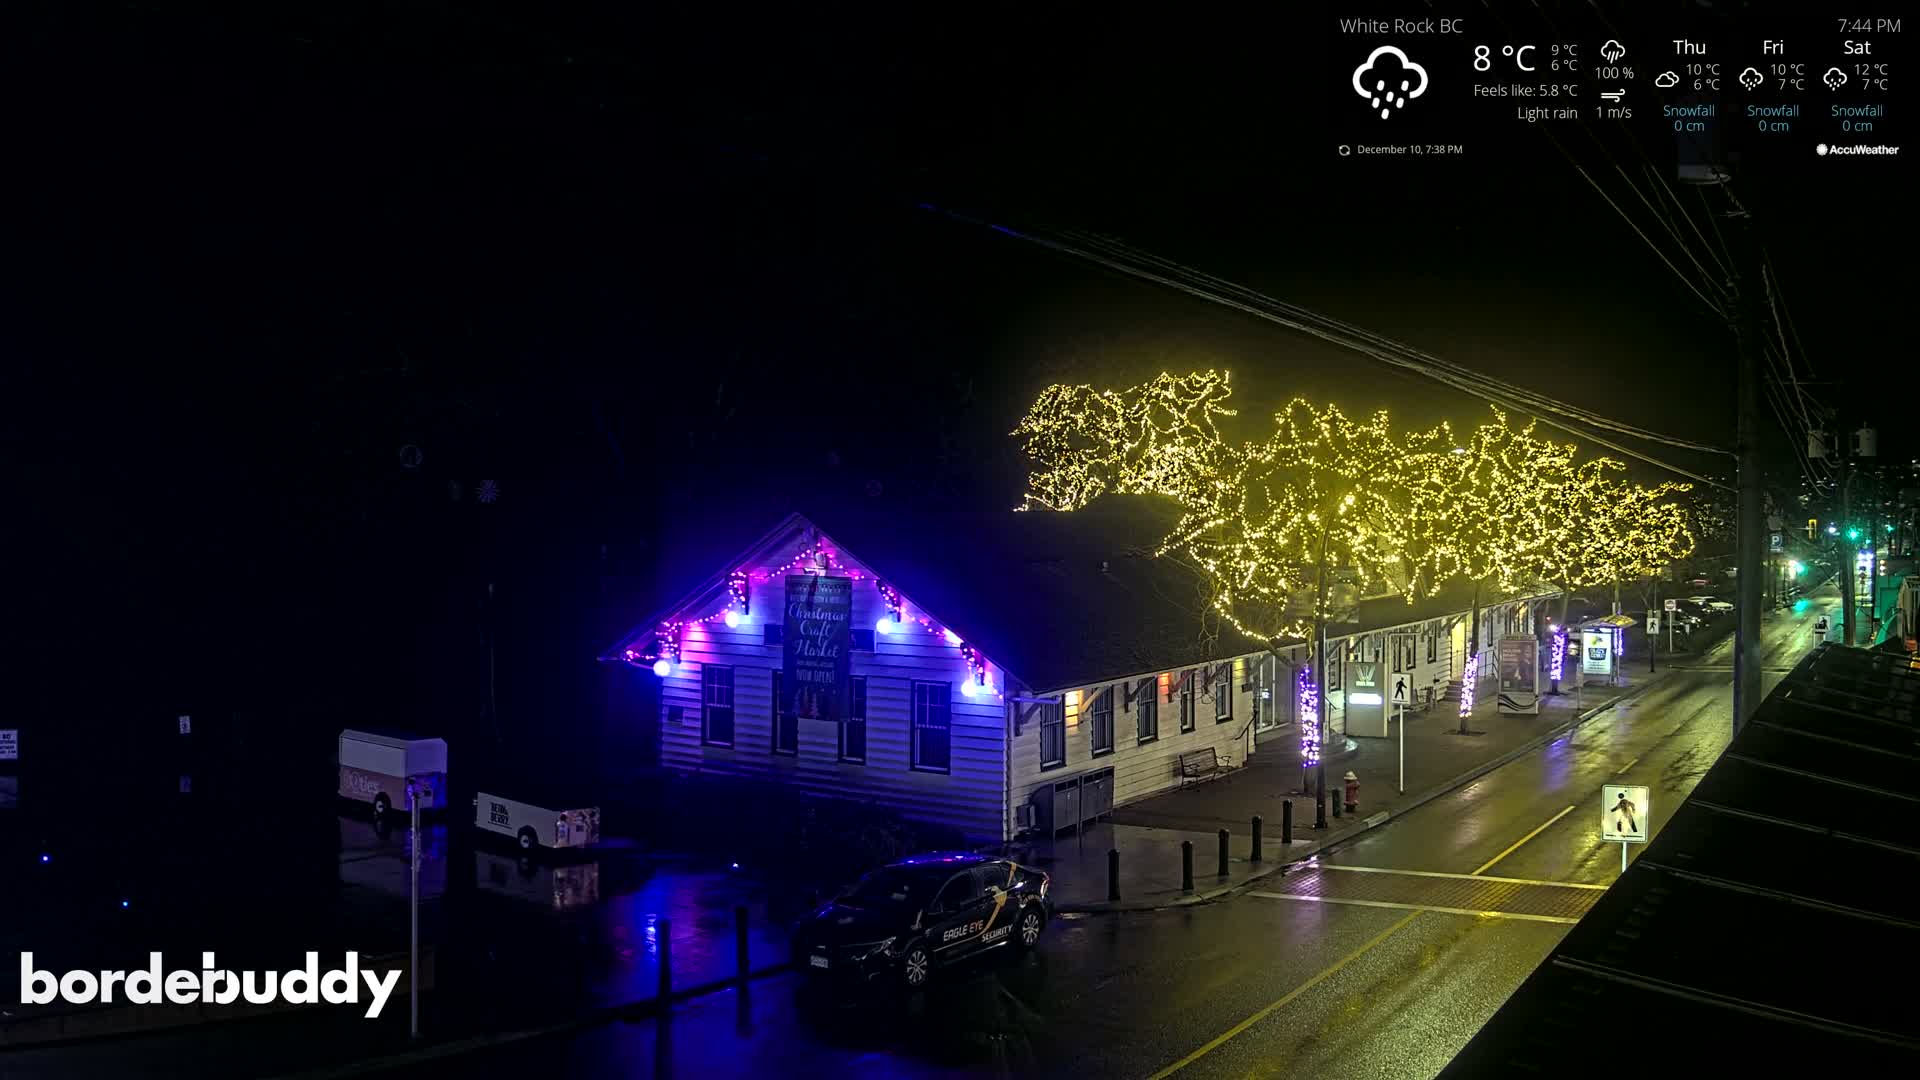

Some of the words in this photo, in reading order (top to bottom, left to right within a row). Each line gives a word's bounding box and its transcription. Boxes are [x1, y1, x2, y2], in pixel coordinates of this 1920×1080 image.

[788, 602, 847, 622] Christmas
[800, 619, 832, 647] Craft
[793, 639, 840, 658] Market
[943, 923, 968, 942] EAGLE
[969, 919, 985, 934] EYE
[981, 923, 1014, 942] SECURITY
